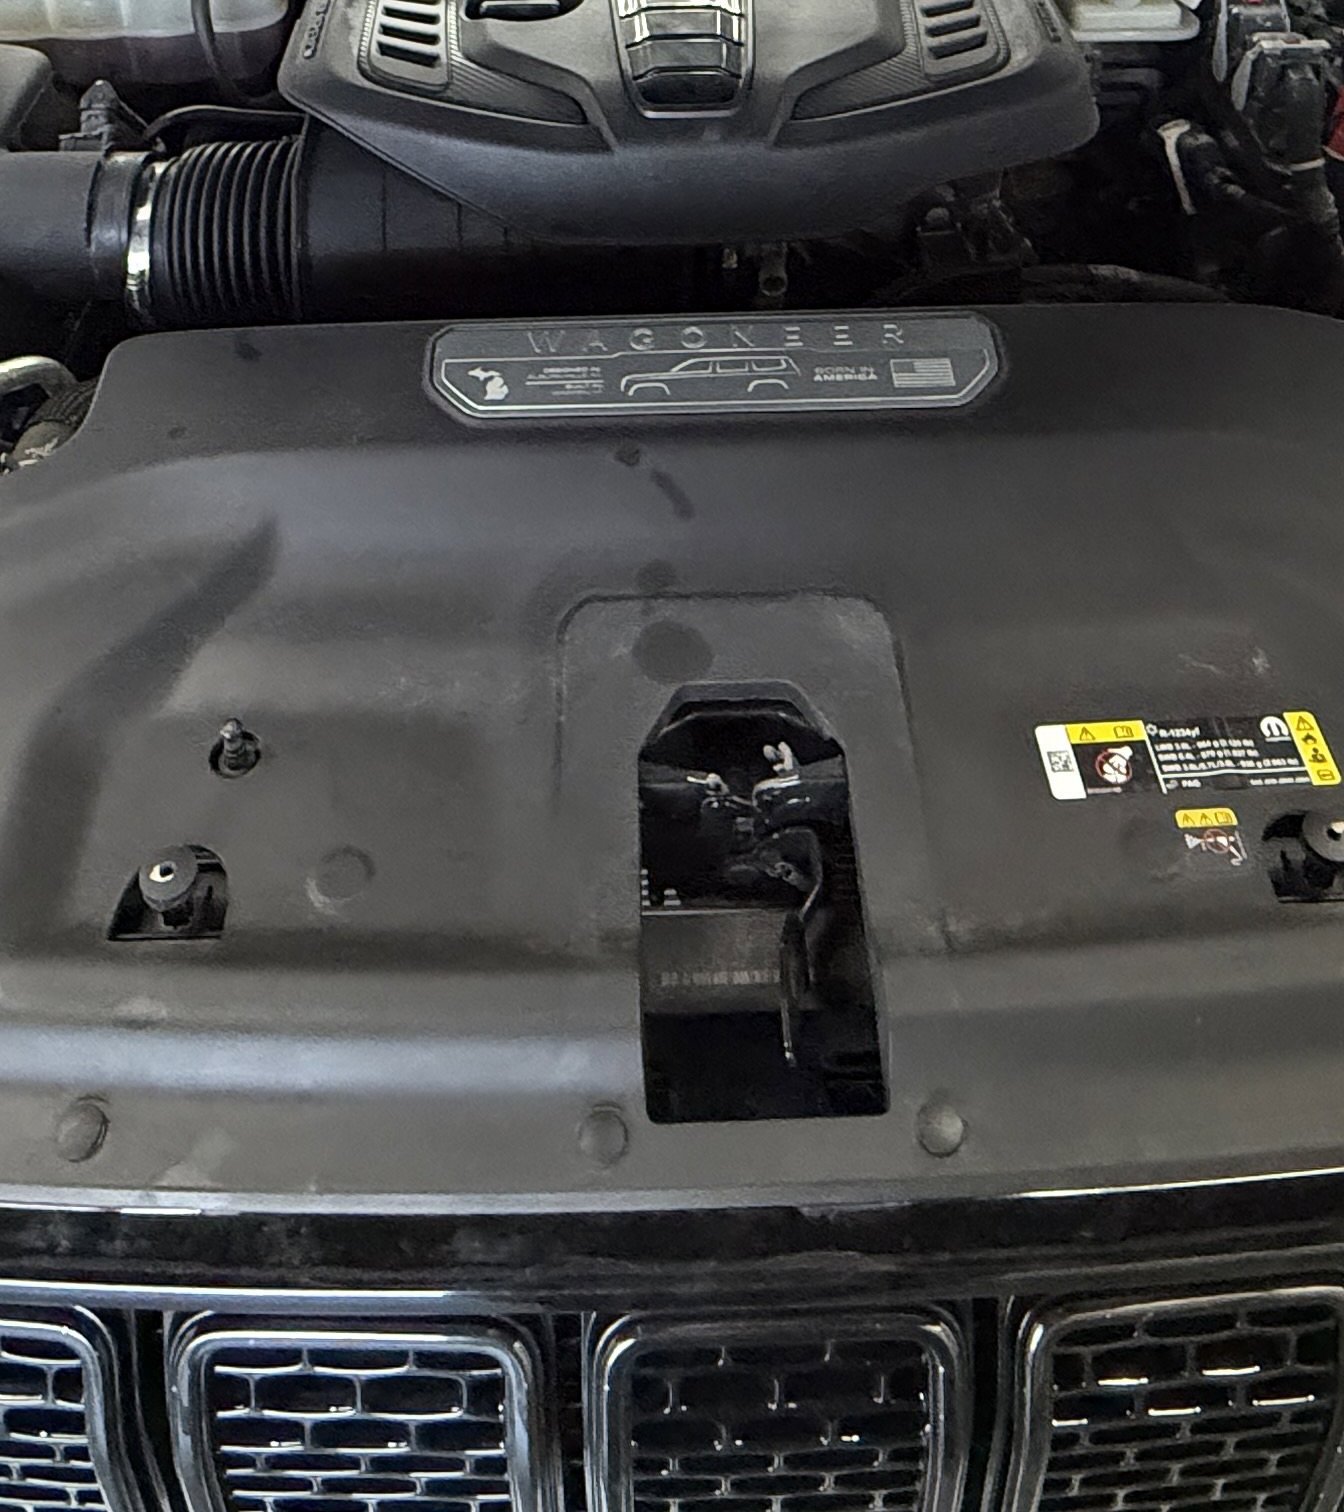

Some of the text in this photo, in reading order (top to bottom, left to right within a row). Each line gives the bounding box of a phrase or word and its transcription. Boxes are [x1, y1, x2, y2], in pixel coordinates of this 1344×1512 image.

[526, 324, 905, 354] WAGONEER
[813, 366, 856, 375] BORN
[813, 373, 878, 382] AMERICA
